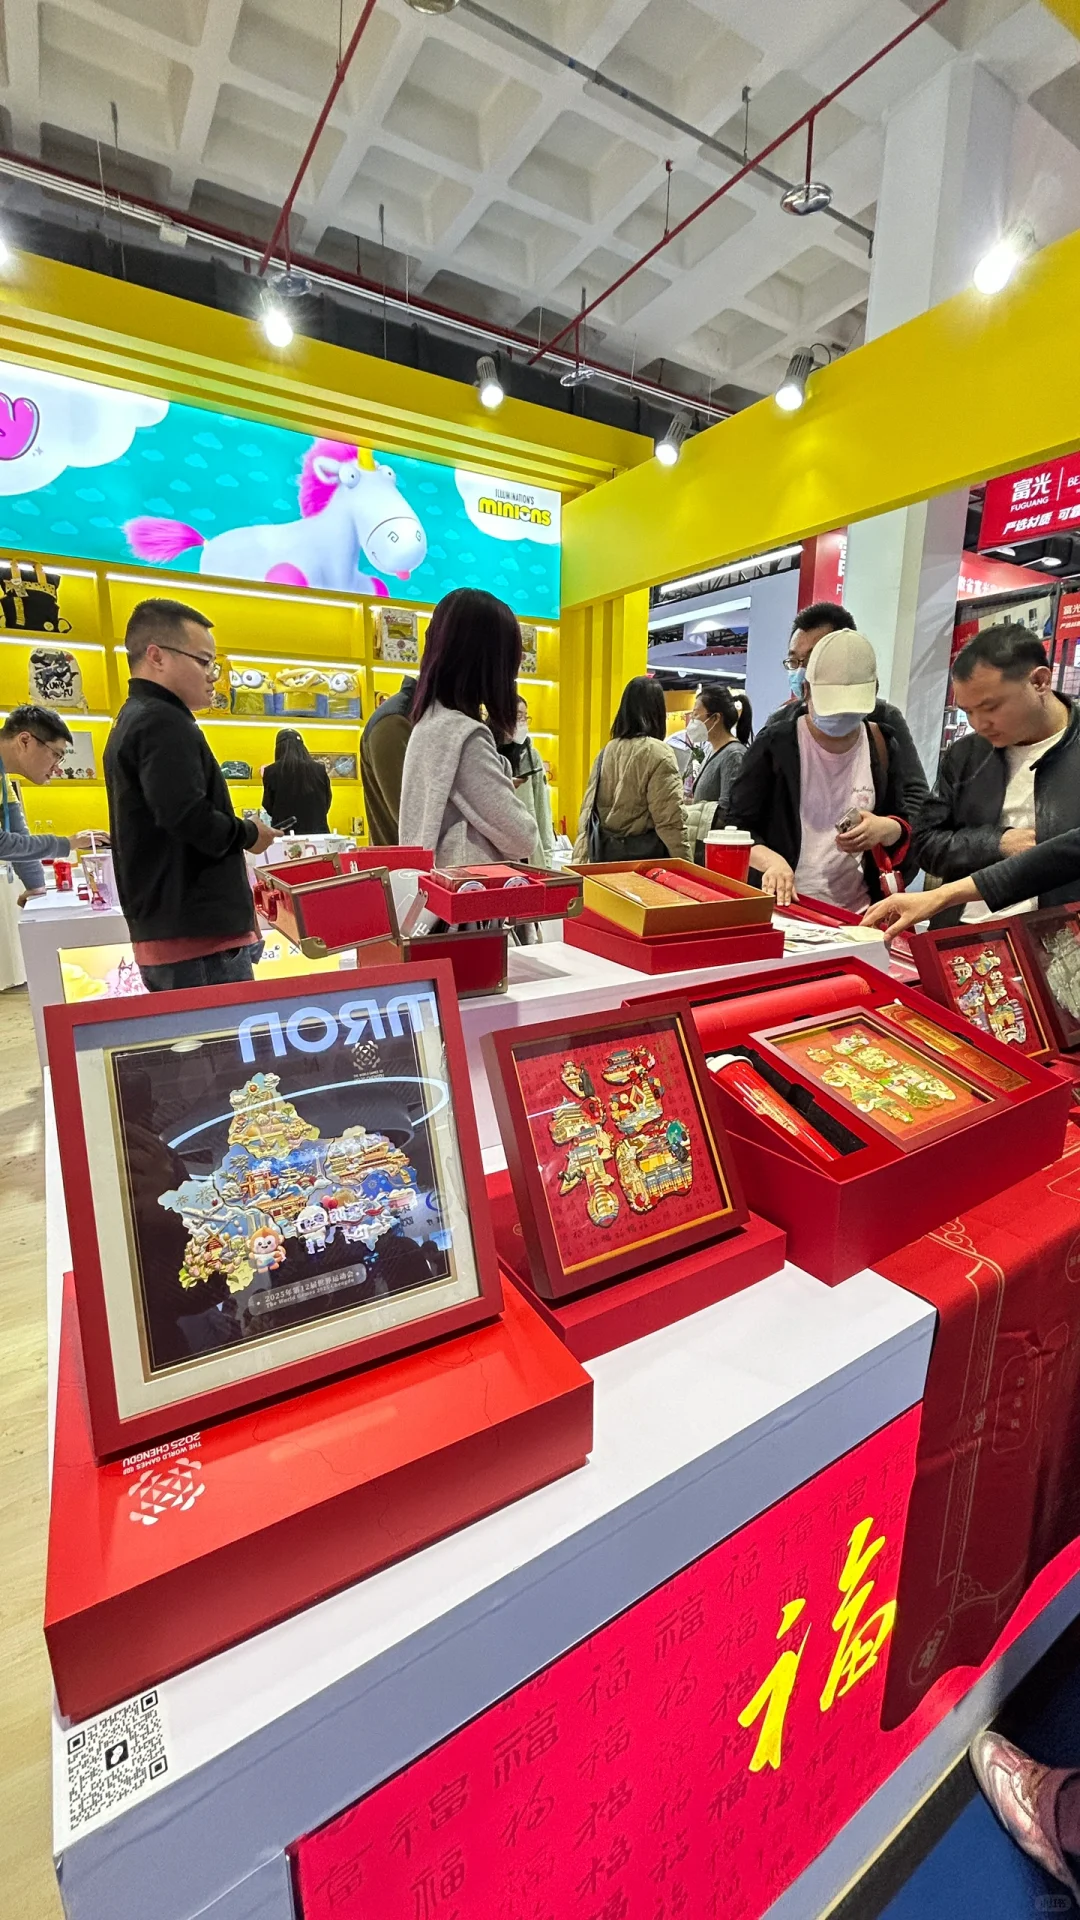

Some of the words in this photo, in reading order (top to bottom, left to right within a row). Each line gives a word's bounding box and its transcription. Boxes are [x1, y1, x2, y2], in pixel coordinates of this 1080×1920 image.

[1012, 472, 1052, 503] 富光
[1010, 496, 1049, 513] FUGUANG
[266, 1301, 277, 1309] The
[279, 1295, 296, 1306] World
[171, 1432, 201, 1450] 2025
[188, 1442, 202, 1450] THE
[123, 1443, 170, 1468] CHENGDU
[162, 1446, 188, 1460] WORLD
[136, 1457, 161, 1471] GAMES
[737, 1517, 897, 1773] 福
[494, 1702, 559, 1788] 福
[390, 1772, 468, 1858] 福
